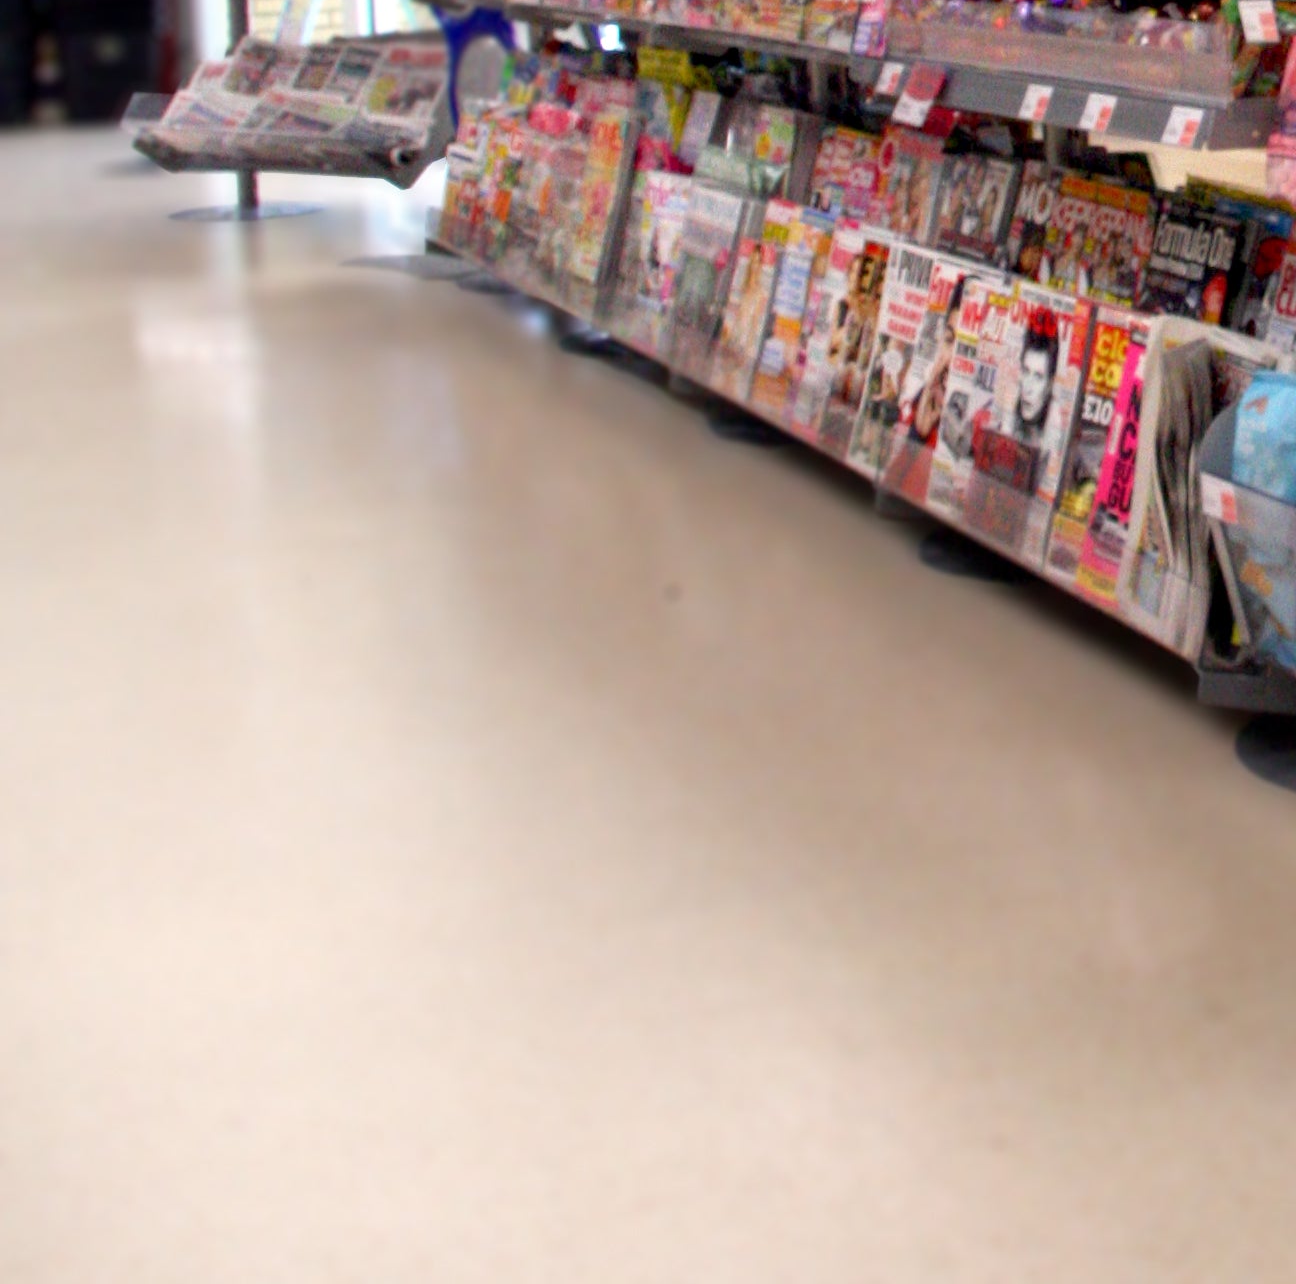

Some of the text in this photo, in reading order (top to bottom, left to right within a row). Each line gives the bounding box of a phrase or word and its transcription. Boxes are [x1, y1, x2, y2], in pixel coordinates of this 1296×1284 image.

[1153, 215, 1211, 266] Formula
[1207, 226, 1236, 270] One
[1011, 294, 1075, 344] UNCUT
